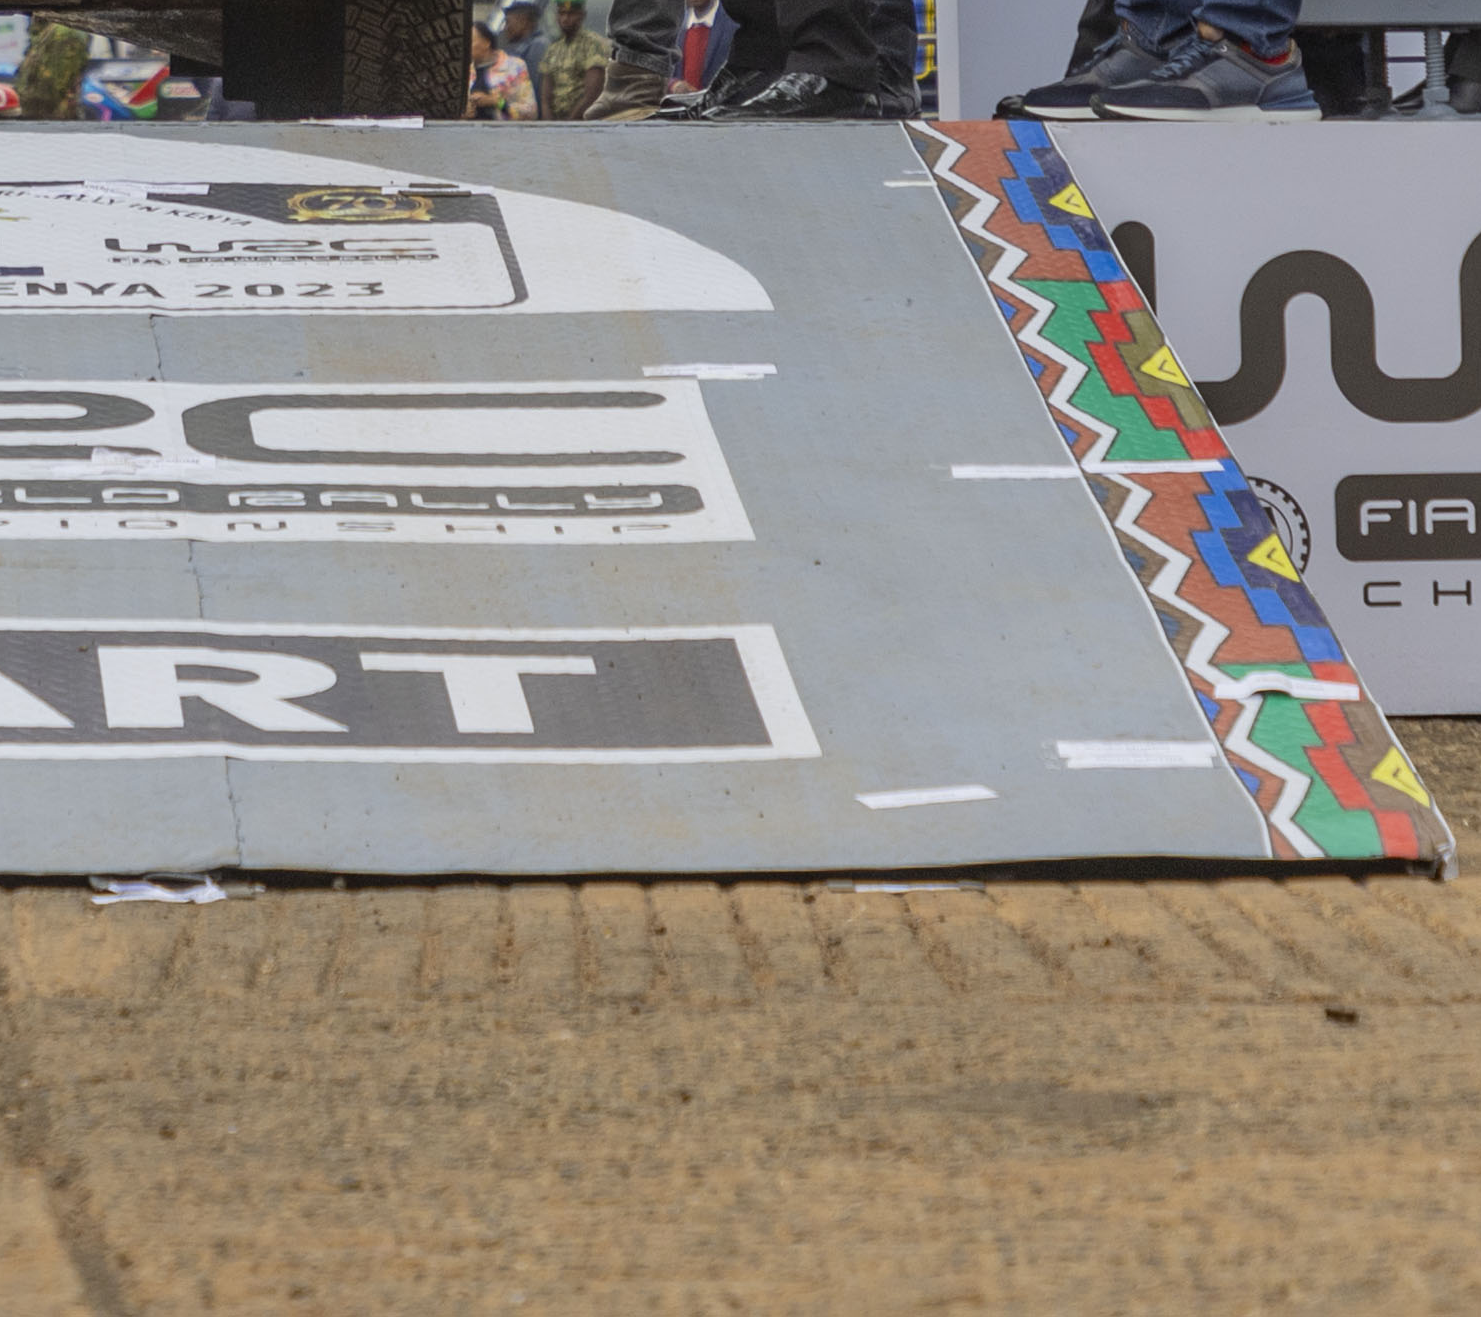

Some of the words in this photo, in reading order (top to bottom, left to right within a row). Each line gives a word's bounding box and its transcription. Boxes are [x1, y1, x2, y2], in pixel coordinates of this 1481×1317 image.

[104, 237, 439, 254] WRC
[194, 281, 386, 298] 2023
[226, 487, 664, 511] RALLY
[1359, 497, 1476, 538] FIA
